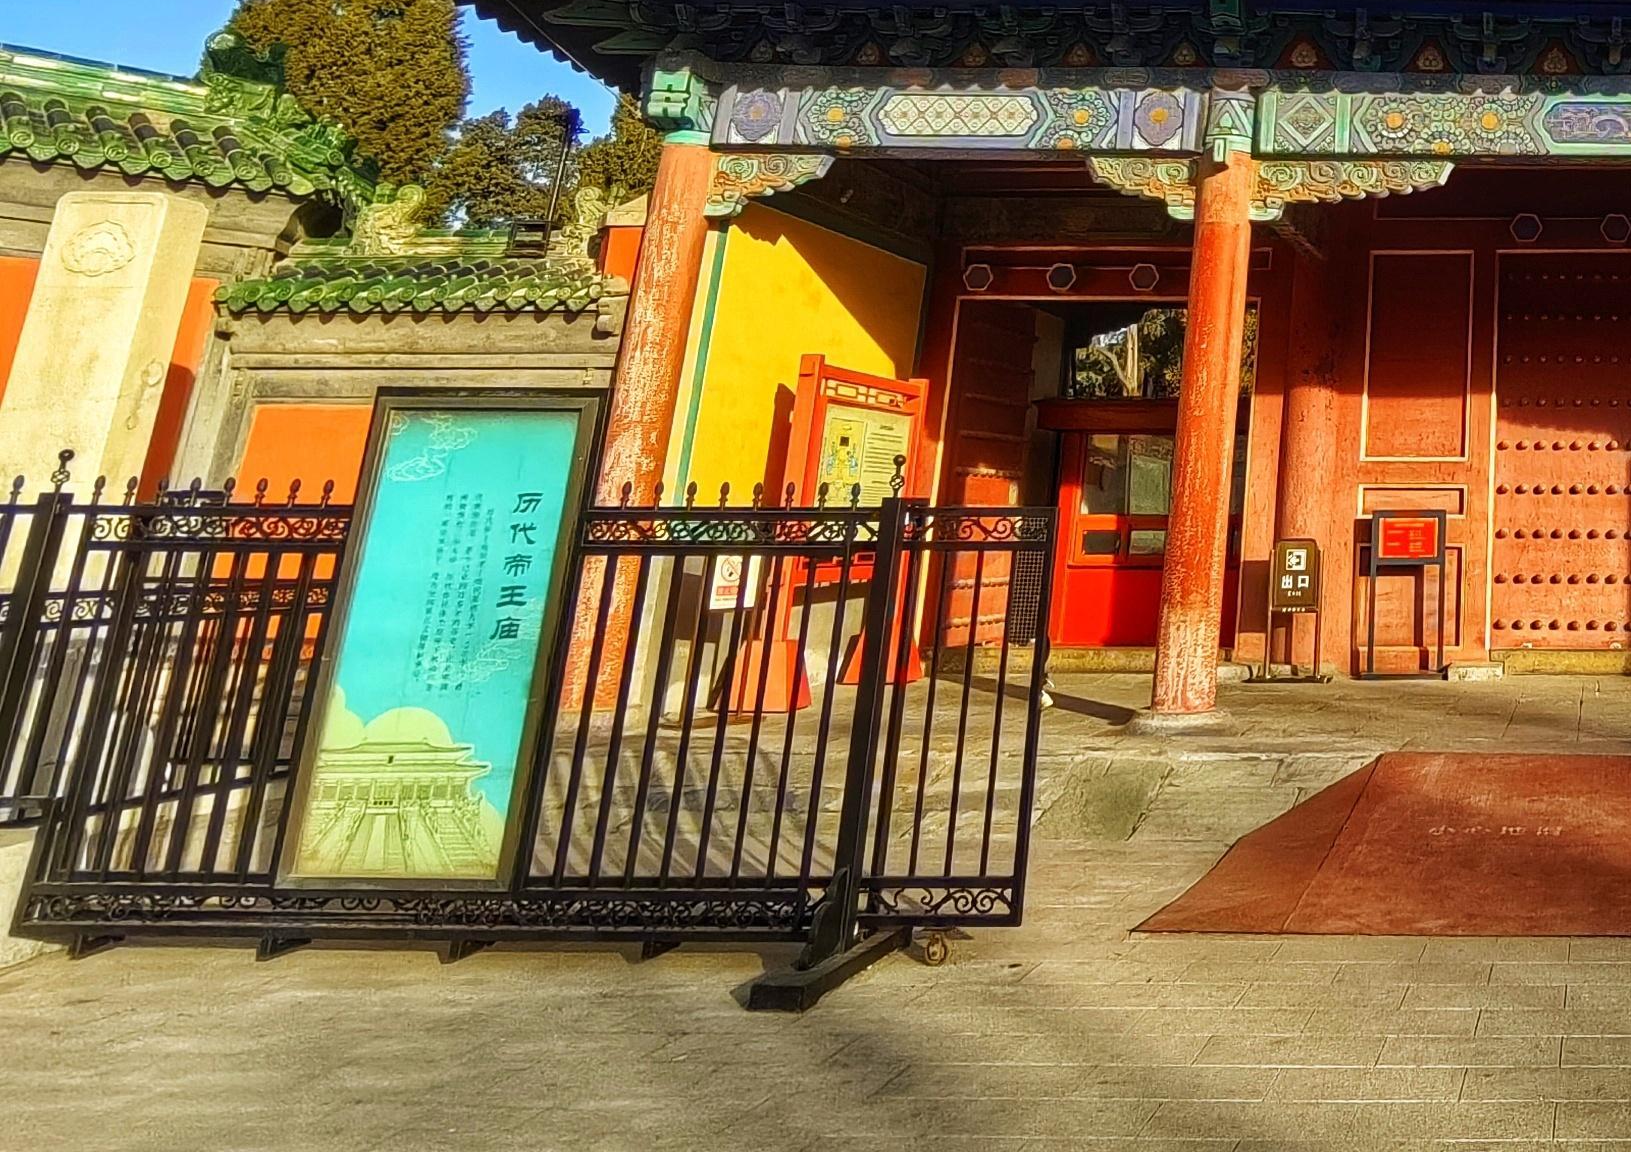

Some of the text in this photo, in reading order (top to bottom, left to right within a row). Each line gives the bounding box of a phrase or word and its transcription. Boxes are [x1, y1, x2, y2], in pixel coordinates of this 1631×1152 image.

[489, 491, 545, 643] 历代帝王庙
[1281, 574, 1310, 589] 出口
